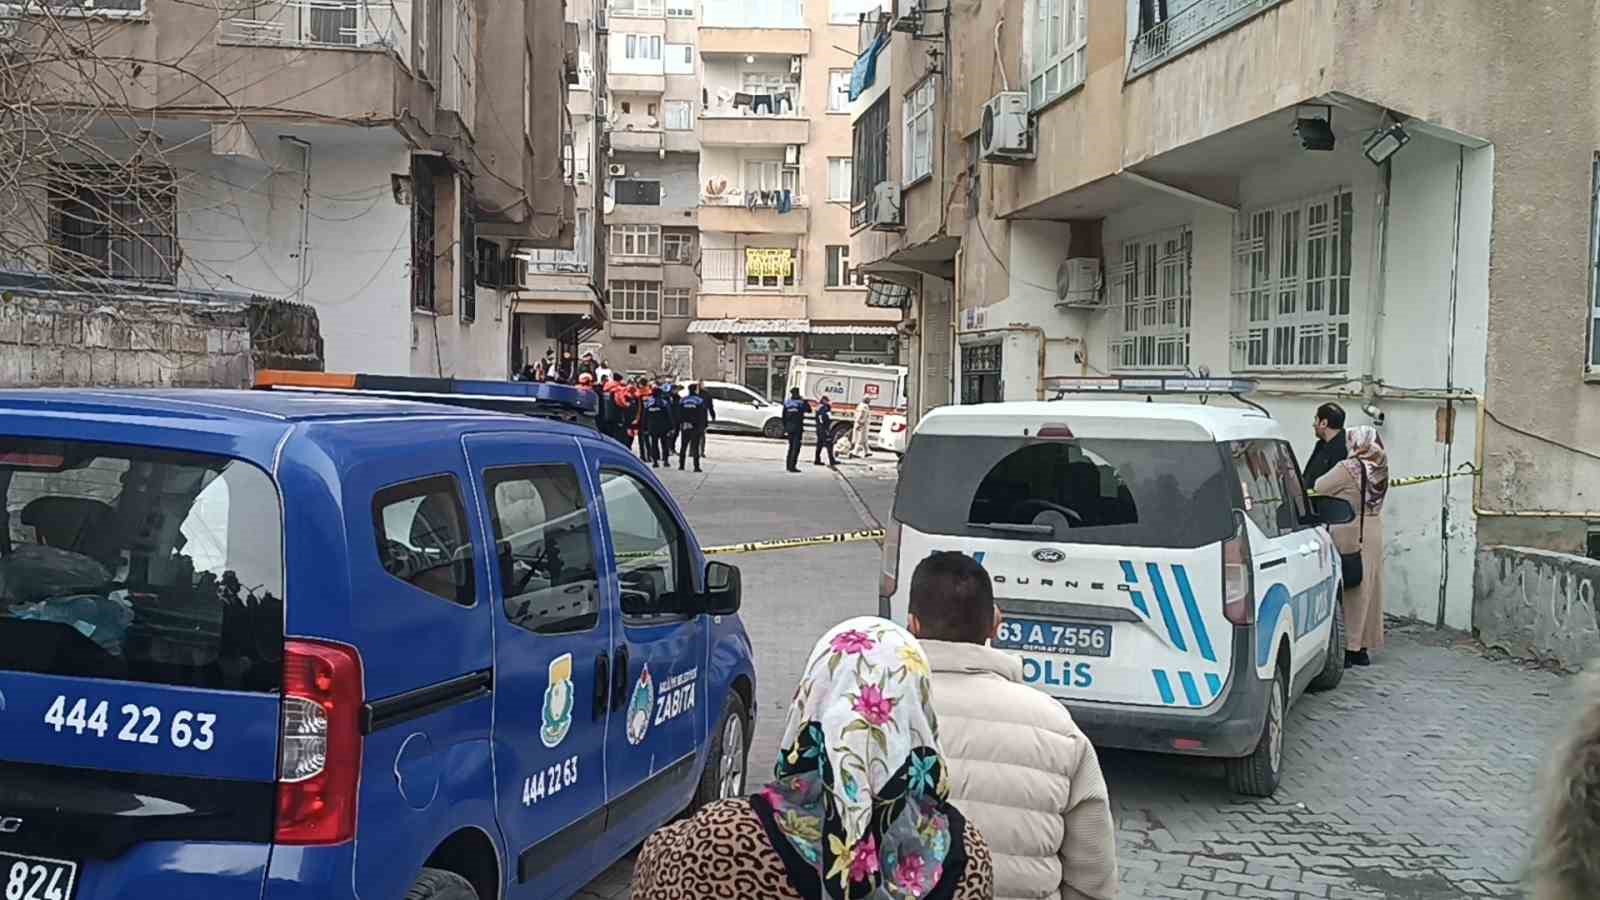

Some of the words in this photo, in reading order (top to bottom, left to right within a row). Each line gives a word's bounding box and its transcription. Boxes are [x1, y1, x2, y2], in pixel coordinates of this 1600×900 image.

[993, 575, 1130, 592] OURNEO
[997, 622, 1022, 642] 63
[1028, 623, 1045, 644] A
[1051, 626, 1105, 649] 7556
[1023, 657, 1093, 688] OLiS
[44, 695, 109, 738] 444
[118, 704, 161, 744] 22
[170, 710, 217, 751] 63
[654, 682, 696, 727] ZABITA
[523, 770, 545, 807] 444
[548, 763, 561, 795] 22
[563, 755, 578, 786] 63
[6, 861, 64, 900] 824
